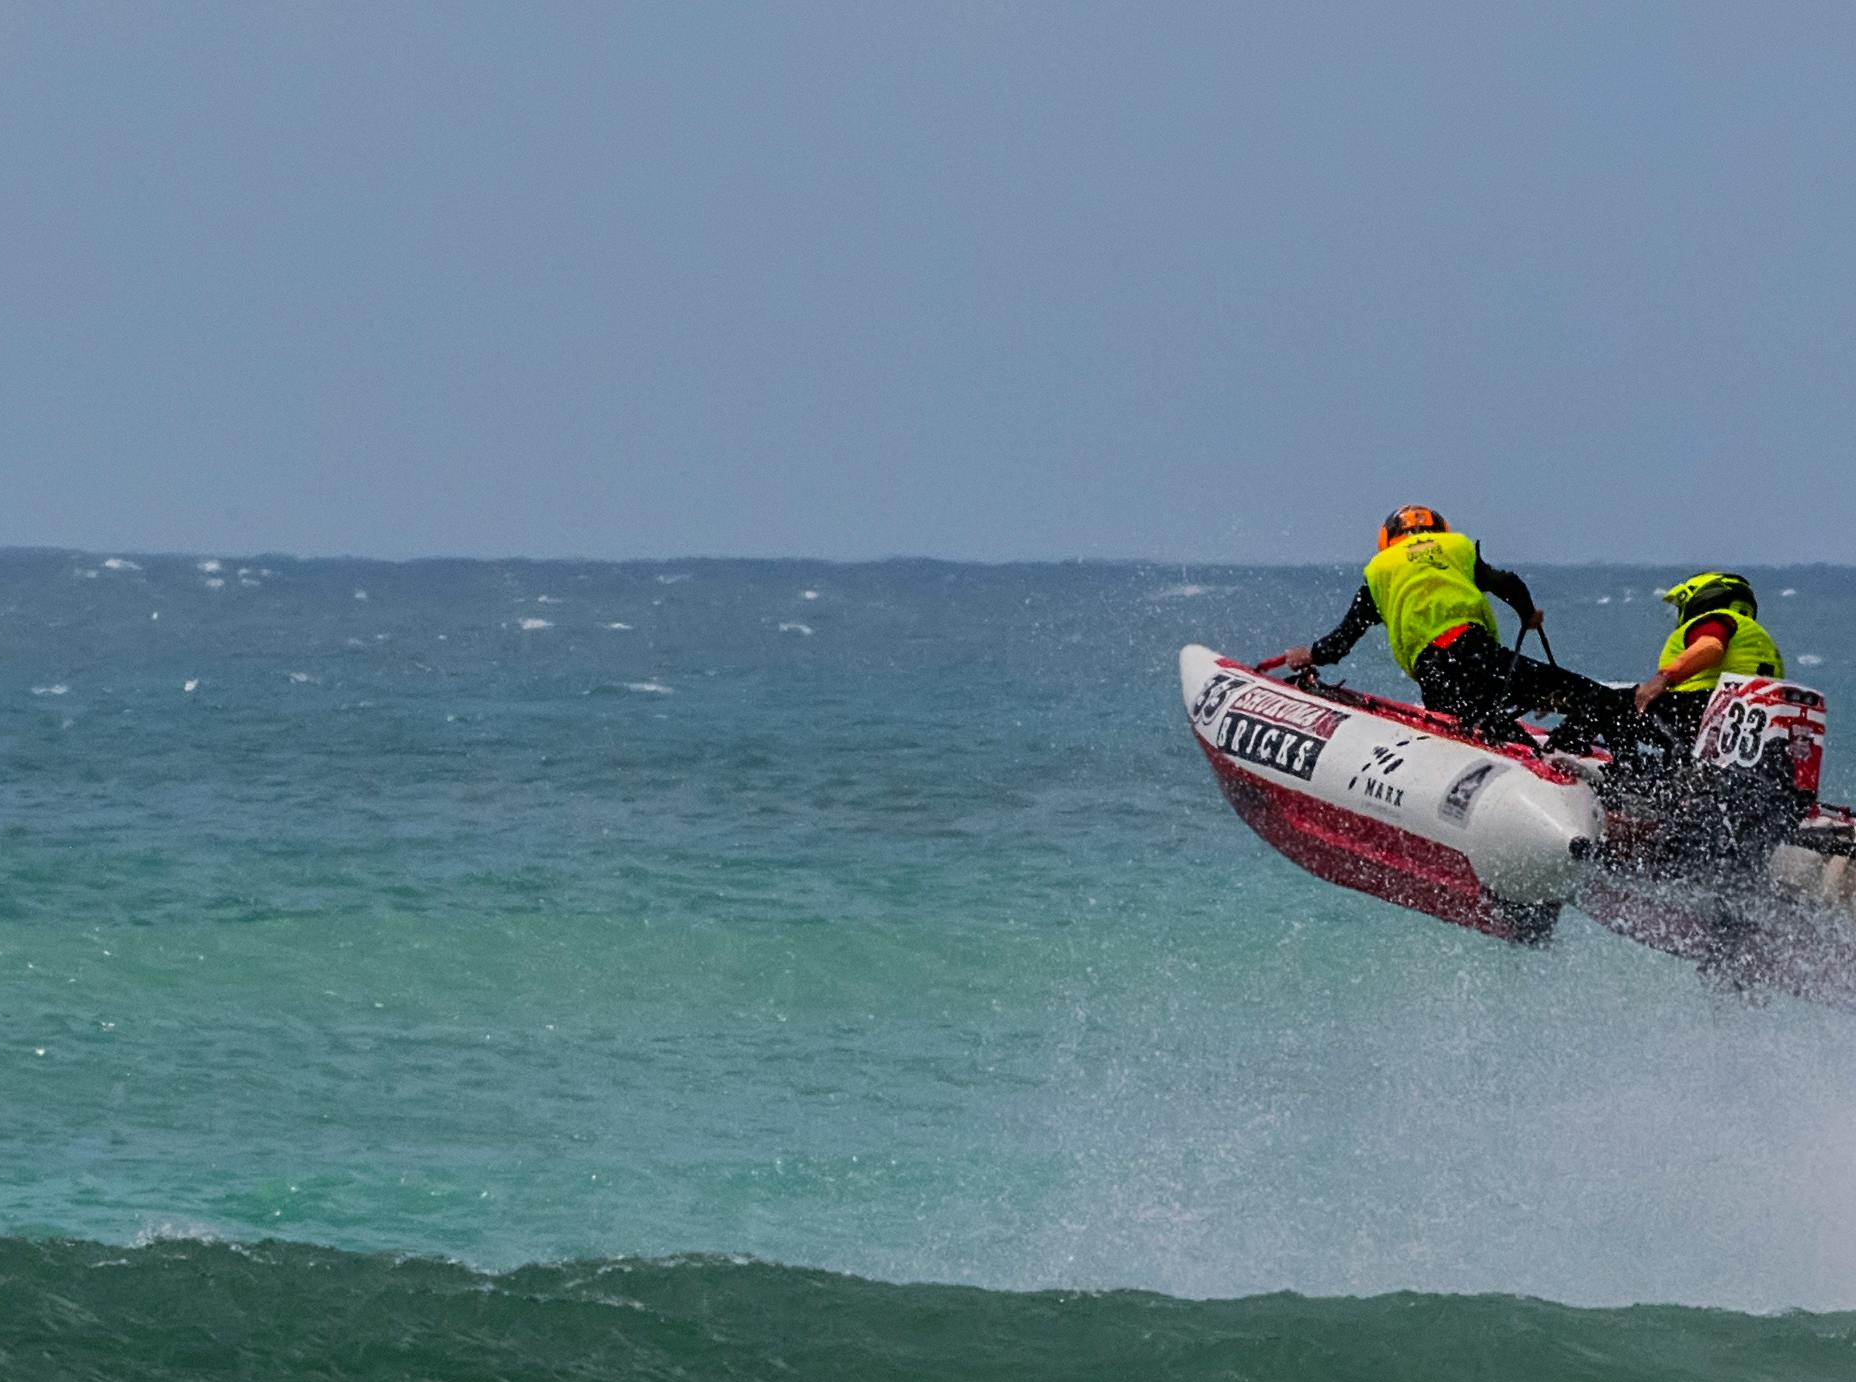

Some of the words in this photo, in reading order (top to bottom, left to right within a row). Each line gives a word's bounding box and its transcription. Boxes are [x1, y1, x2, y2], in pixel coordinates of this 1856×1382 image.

[1193, 674, 1247, 719] 33
[1216, 716, 1315, 772] BRICKS
[1720, 702, 1767, 761] 33
[1365, 778, 1404, 807] MARX
